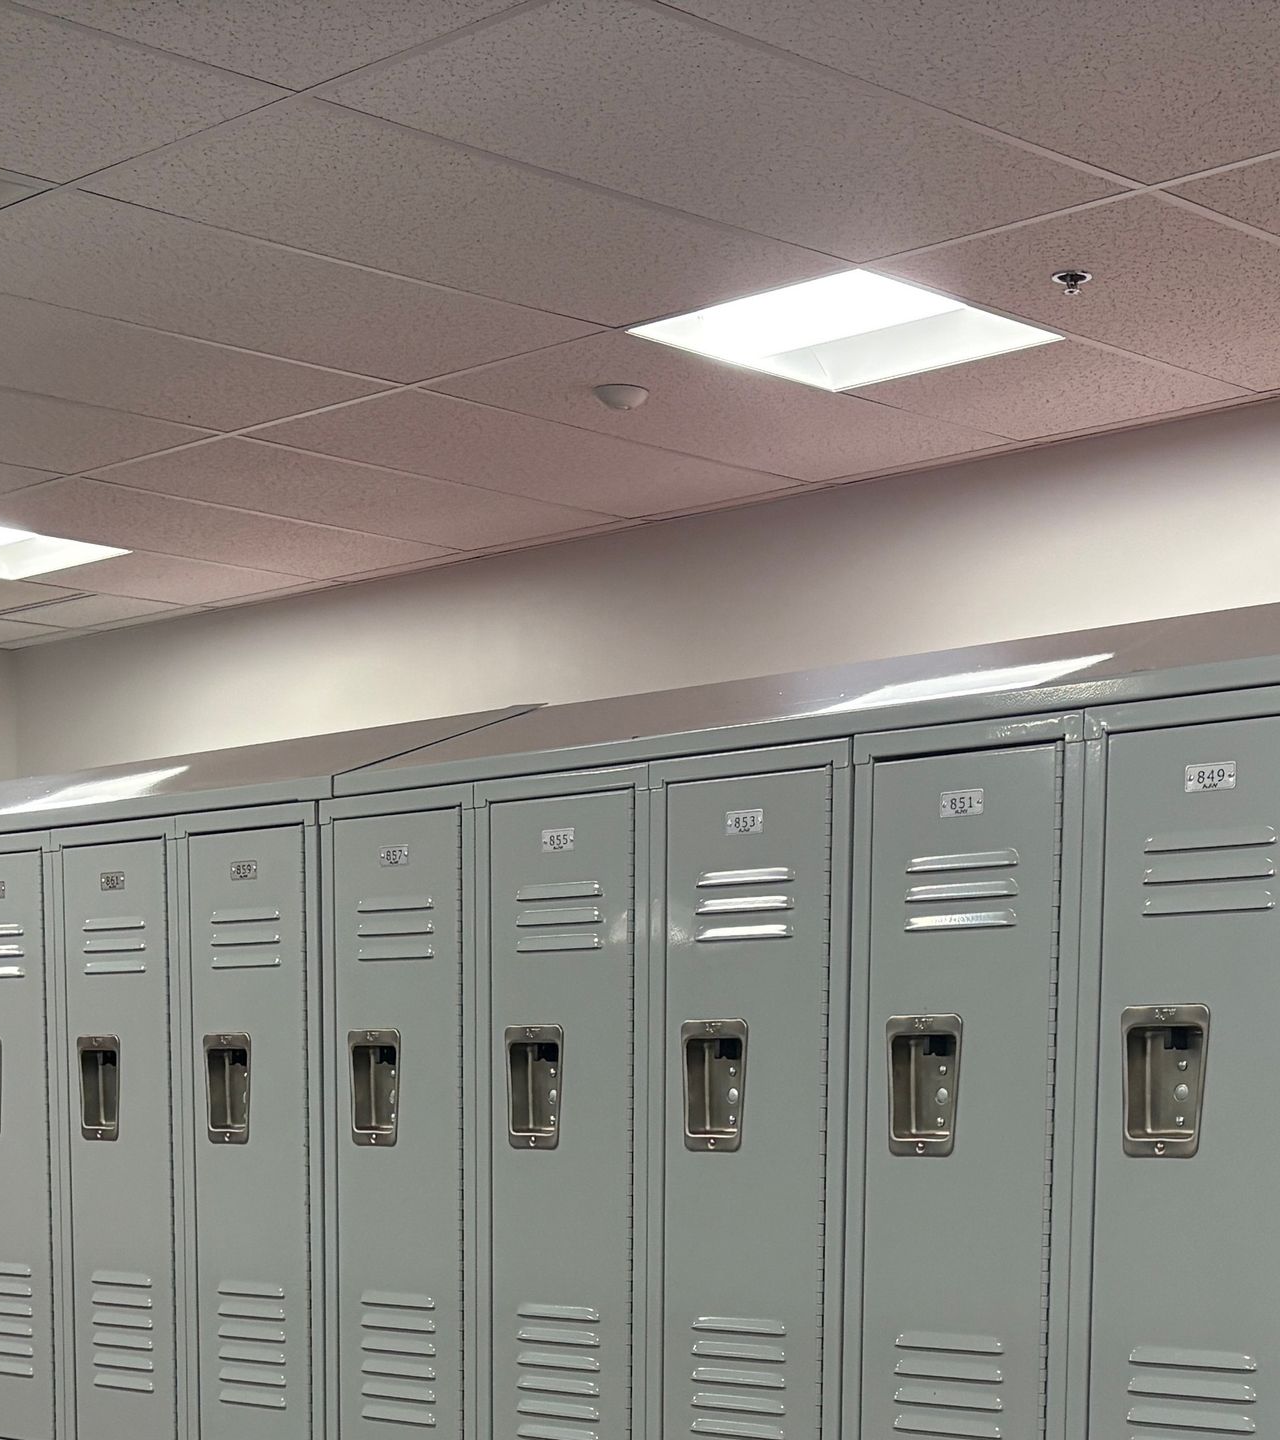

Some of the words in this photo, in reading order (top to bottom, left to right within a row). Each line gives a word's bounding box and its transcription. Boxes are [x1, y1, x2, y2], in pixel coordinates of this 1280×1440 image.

[1197, 768, 1226, 785] 849
[949, 796, 972, 810] 851
[734, 815, 756, 829] 853
[549, 834, 568, 846] 855
[386, 849, 402, 861] 857
[236, 864, 252, 875] 859
[105, 875, 119, 886] 861
